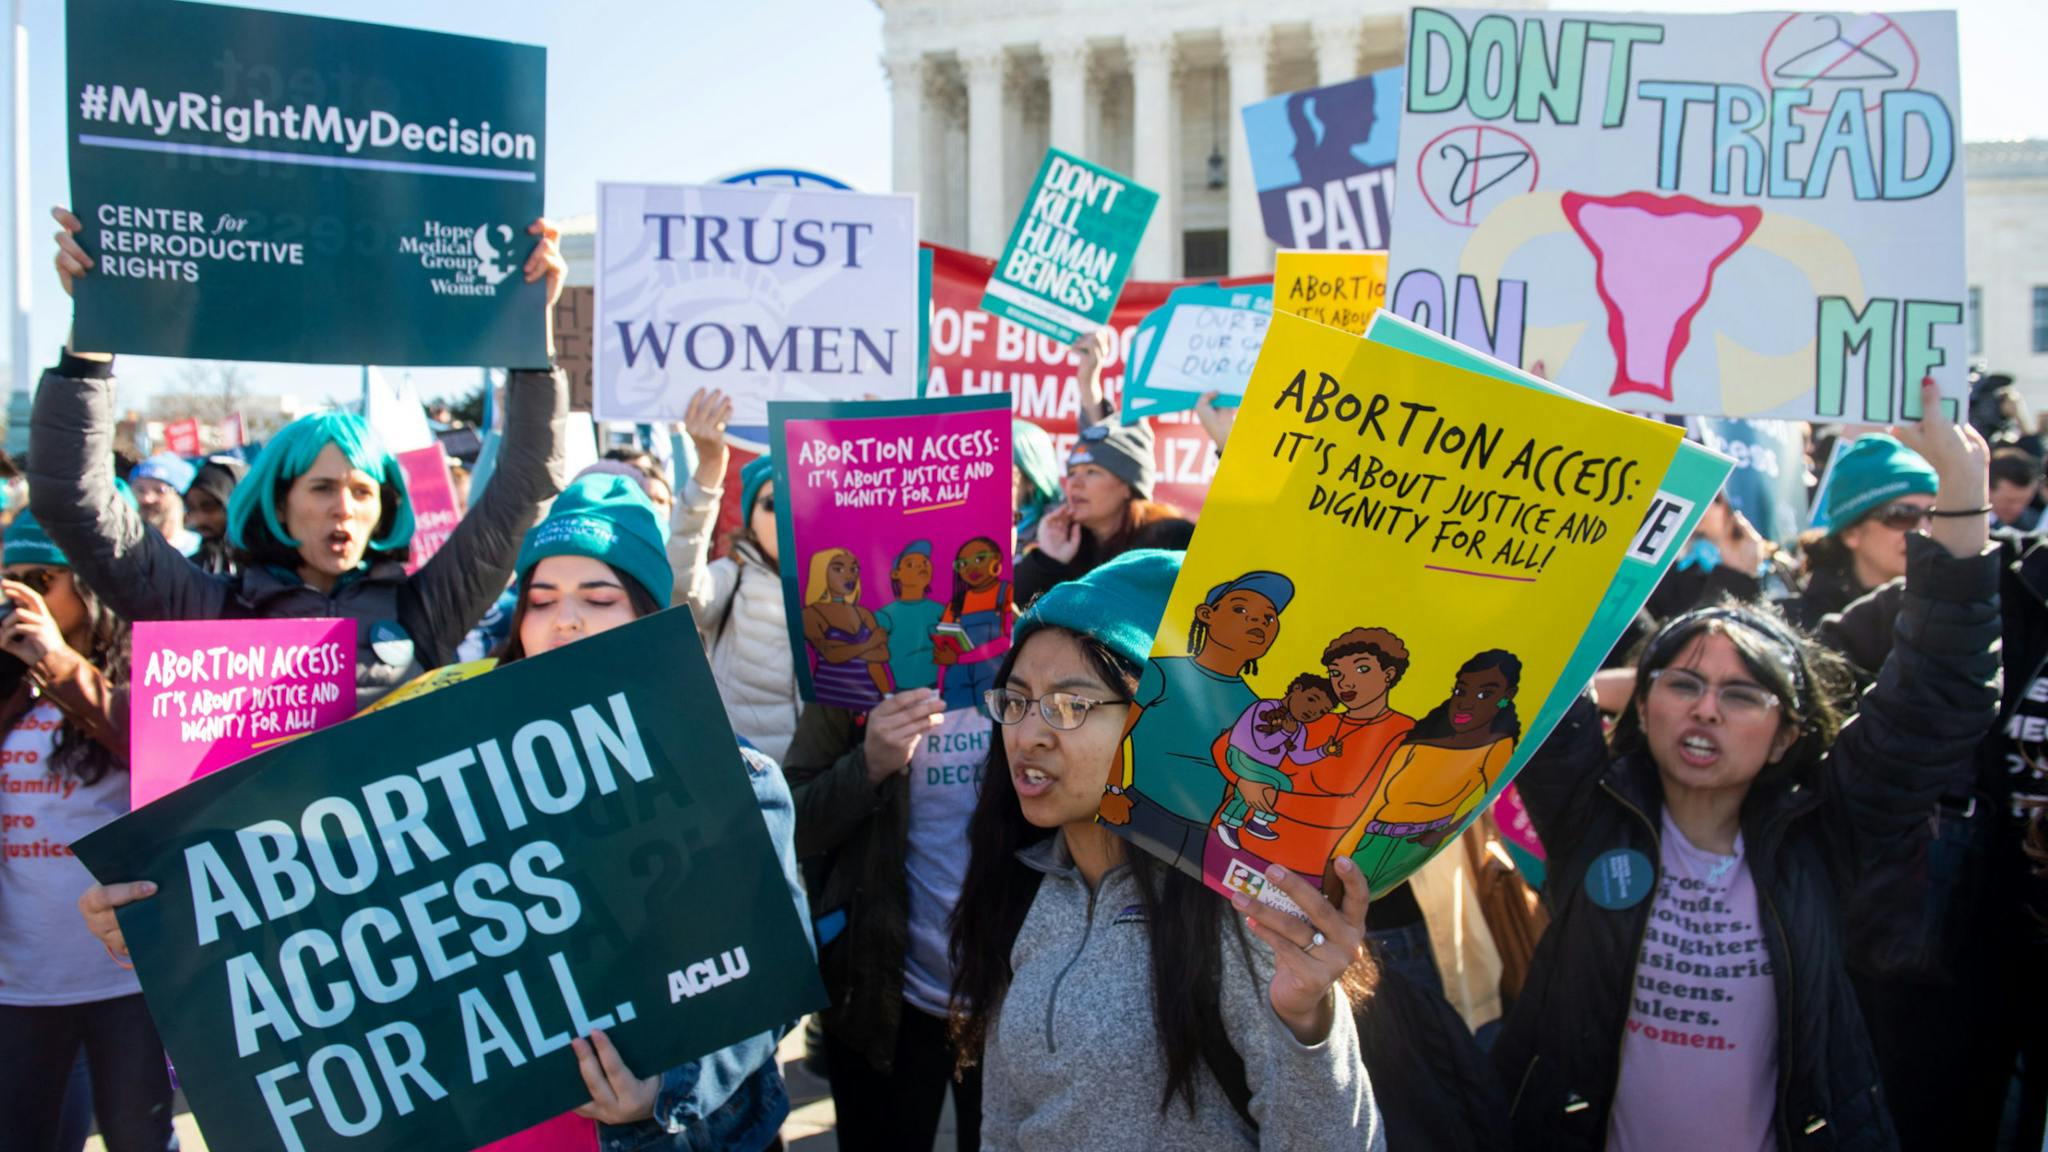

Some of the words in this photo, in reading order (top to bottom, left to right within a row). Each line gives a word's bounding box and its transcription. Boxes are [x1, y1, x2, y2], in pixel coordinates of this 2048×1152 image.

[1407, 7, 1664, 128] DONT
[80, 84, 536, 161] #MyRightMyDecision
[1637, 80, 1955, 200] TREAD
[1043, 157, 1126, 214] DON'T
[98, 204, 204, 233] CENTER
[212, 214, 247, 236] for
[424, 220, 474, 242] Hope
[1030, 188, 1085, 235] KILL
[101, 229, 304, 265] REPRODUCTIVE
[399, 237, 472, 257] Medical
[421, 253, 479, 275] Group
[643, 213, 873, 269] TRUST
[1018, 218, 1117, 284] HUMAN
[101, 255, 199, 283] RIGHTS
[430, 278, 496, 296] Women
[932, 307, 989, 357] OF
[1392, 269, 1527, 369] ON
[614, 320, 898, 376] WOMEN
[1815, 296, 1963, 423] ME
[799, 436, 914, 467] ABORTION
[921, 429, 999, 462] ACCESS:
[1274, 369, 1504, 471] ABORTION
[1502, 438, 1642, 506] ACCESS:
[808, 469, 839, 489] IT'S
[843, 467, 896, 487] ABOUT
[900, 464, 960, 486] JUSTICE
[964, 461, 994, 480] AND
[835, 488, 897, 508] DIGNITY
[902, 486, 932, 507] FOR
[937, 483, 969, 502] ALL!
[1272, 430, 1336, 476] IT'S
[1338, 452, 1446, 504] ABOUT
[1442, 484, 1562, 537] JUSTICE
[1555, 511, 1608, 546] AND
[1307, 484, 1430, 544] DIGNITY
[1431, 520, 1489, 560] FOR
[1491, 536, 1557, 575] ALL!
[144, 647, 264, 687] ABORTION
[270, 643, 346, 678] ACCESS:
[152, 690, 187, 718] IT'S
[191, 686, 247, 716] ABOUT
[249, 683, 308, 711] JUSTICE
[311, 682, 340, 707] AND
[182, 716, 246, 743] DIGNITY
[251, 713, 281, 737] FOR
[285, 709, 317, 731] ALL!
[1, 774, 79, 800] family
[2, 814, 35, 832] pro
[185, 693, 653, 946] ABORTION
[226, 841, 581, 1057] ACCESS
[668, 947, 751, 1004] ACLU
[257, 1021, 448, 1152] FOR
[457, 952, 636, 1084] ALL.
